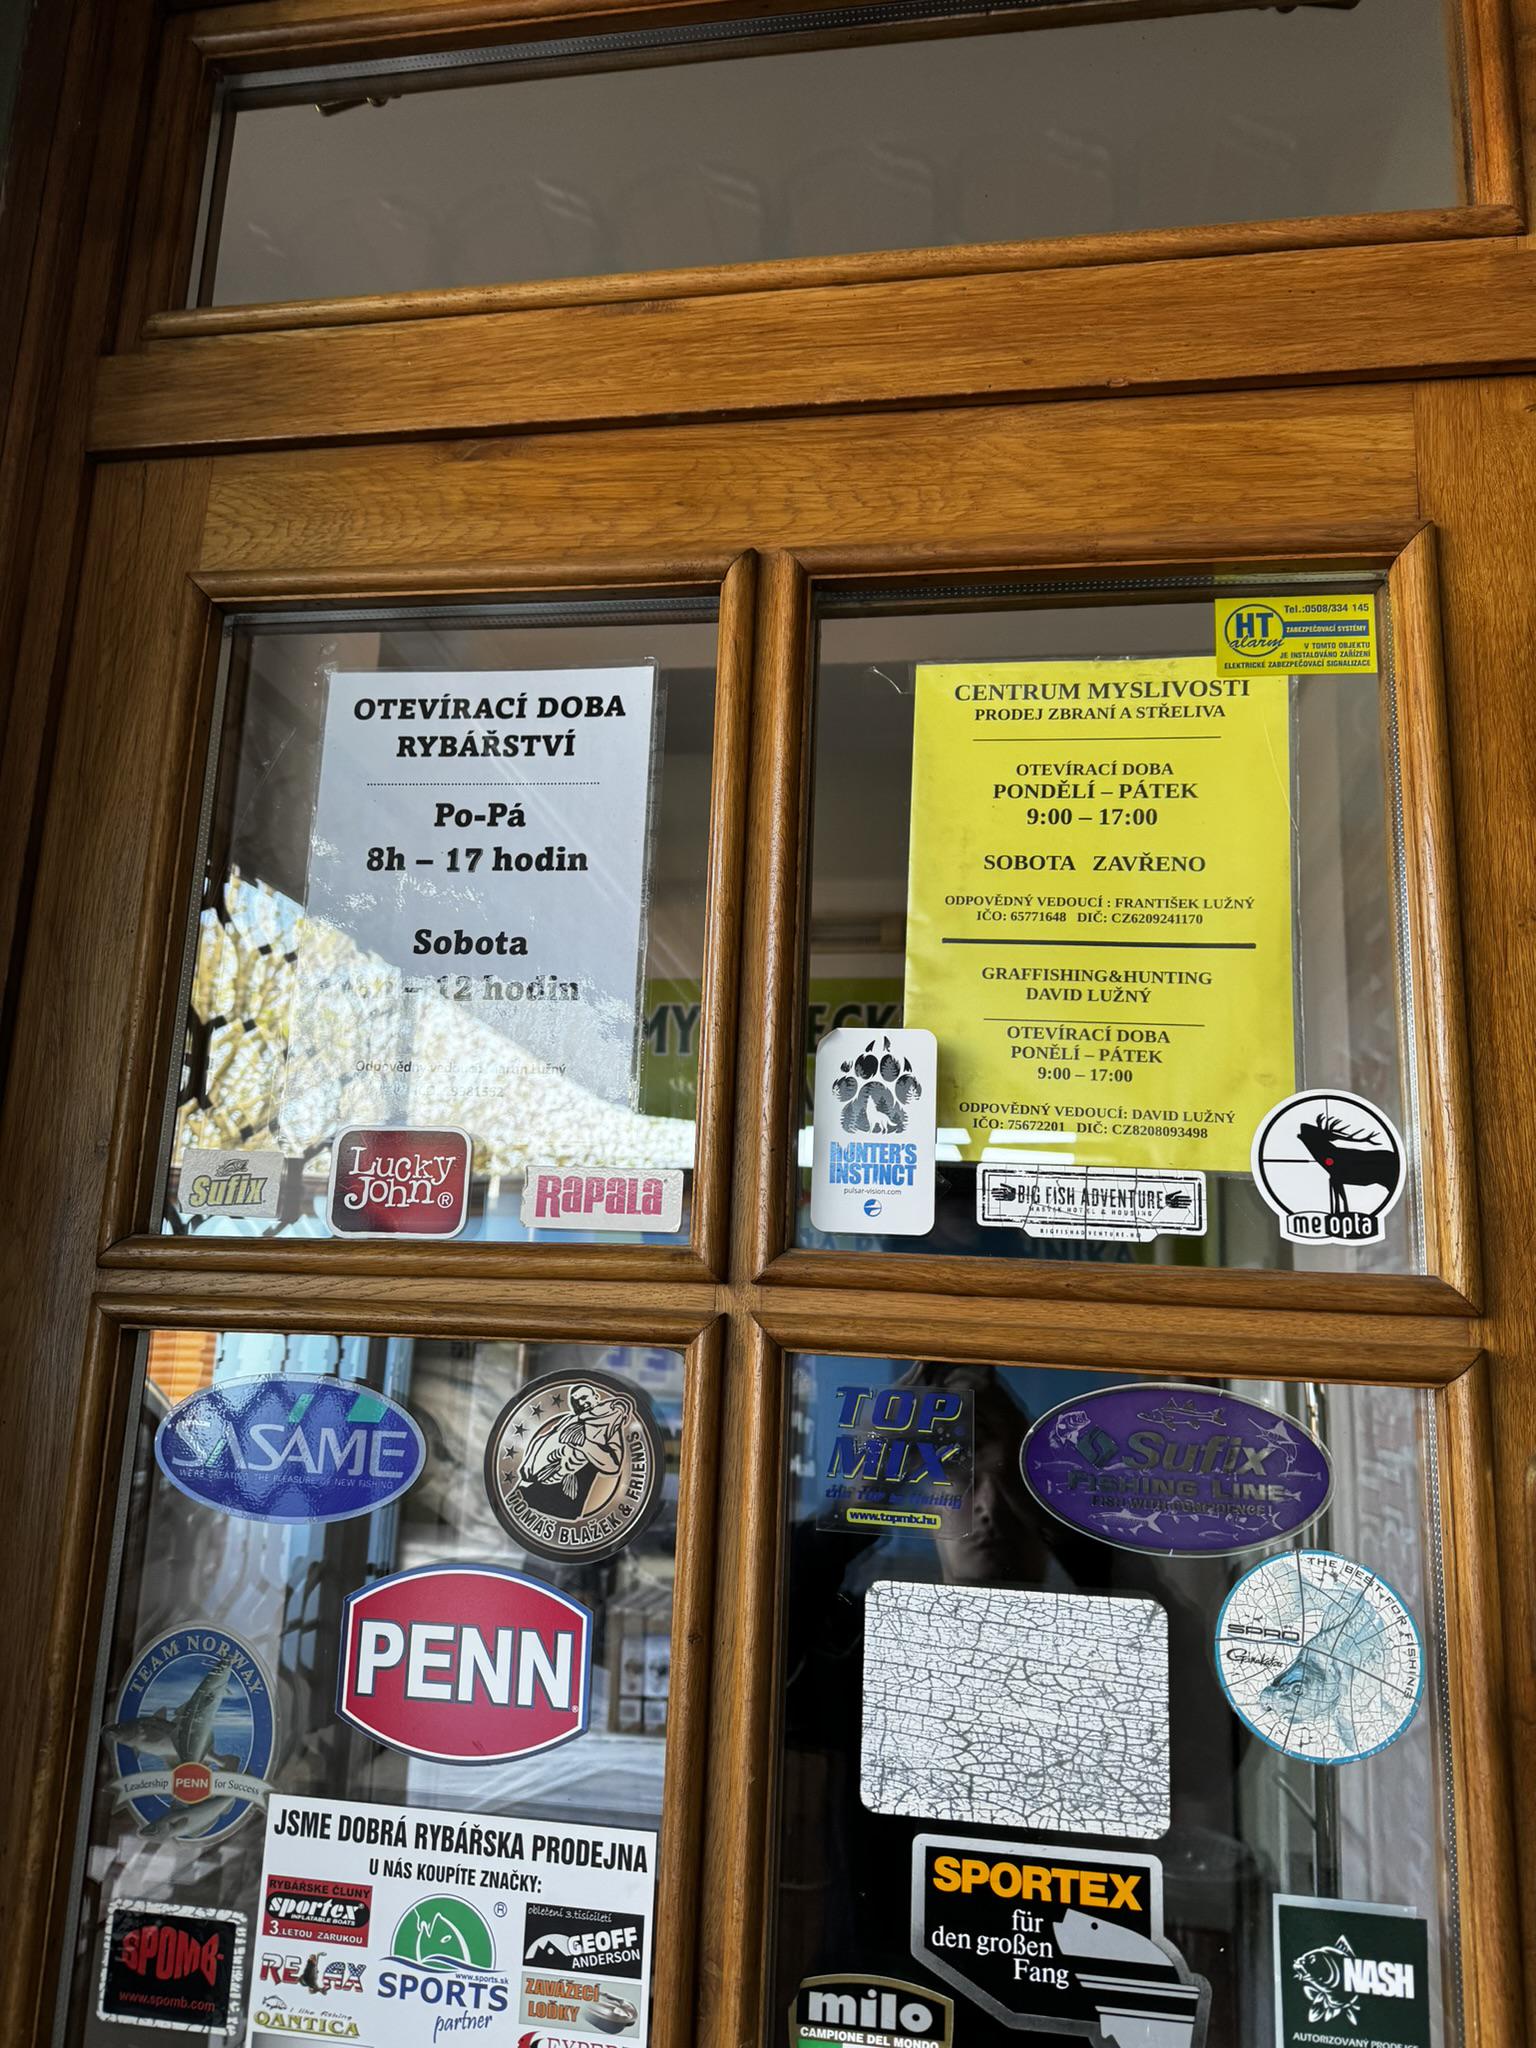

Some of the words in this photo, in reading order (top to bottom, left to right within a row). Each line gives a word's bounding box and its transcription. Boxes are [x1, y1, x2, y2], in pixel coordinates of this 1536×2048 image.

[1352, 603, 1369, 612] 145
[1236, 613, 1274, 638] HT
[1229, 635, 1284, 648] alarm
[954, 682, 1079, 701] CENTRUM
[1087, 679, 1250, 700] MYSLIVOSTI
[354, 693, 528, 720] OTEVÍRACÍ
[537, 695, 626, 720] DOBA
[975, 707, 1043, 721] PRODEJ
[1048, 704, 1117, 721] ZBRANÍ
[1119, 706, 1132, 720] A
[1136, 703, 1226, 720] STŘELIVA
[396, 729, 576, 757] RYBÁŘSTVÍ
[1016, 760, 1117, 777] OTEVÍRACÍ
[1122, 763, 1174, 776] DOBA
[993, 780, 1095, 800] PONDĚLÍ
[1118, 780, 1199, 799] PÁTEK
[434, 803, 526, 828] Po-Pá
[1027, 808, 1073, 826] 9:00
[1099, 808, 1158, 826] 17:00
[367, 847, 406, 872] 8h
[447, 848, 484, 873] 17
[492, 847, 588, 872] hodin
[983, 854, 1075, 872] SOBOTA
[1093, 852, 1206, 873] ZAVŘENO
[944, 893, 1034, 908] ODPOVĚDNÝ
[1037, 895, 1103, 909] VEDOUCÍ
[1114, 895, 1200, 910] FRANTIŠEK
[1203, 896, 1255, 910] LUŽNÝ
[976, 909, 1007, 922] IČO:
[1010, 911, 1067, 923] 65771648
[1077, 910, 1107, 924] DIČ:
[1111, 912, 1203, 925] CZ6209241170
[413, 928, 529, 956] Sobota
[483, 974, 579, 1001] hodin
[981, 966, 1213, 986] GRAFFISHING&HUNTING
[1026, 987, 1082, 1002] DAVID
[1087, 986, 1152, 1004] LUŽNÝ
[1007, 1025, 1112, 1042] OTEVÍRACÍ
[1116, 1029, 1170, 1044] DOBA
[1010, 1045, 1080, 1061] PONĚLÍ
[1099, 1047, 1164, 1064] PÁTEK
[1038, 1066, 1071, 1081] 9:00
[1090, 1068, 1133, 1083] 17:00
[959, 1101, 1051, 1116] ODPOVĚDNÝ
[1054, 1104, 1127, 1119] VEDOUCÍ:
[1132, 1108, 1179, 1122] DAVID
[1183, 1109, 1235, 1124] LUŽNÝ
[973, 1115, 1005, 1130] IČO:
[1008, 1119, 1065, 1133] 75672201
[1077, 1120, 1108, 1134] DIČ:
[1112, 1123, 1208, 1139] CZ8208093498
[348, 1146, 456, 1185] Lucky
[829, 1162, 917, 1186] INSTINCT
[189, 1173, 267, 1208] Sufix
[344, 1177, 434, 1210] John
[843, 1186, 902, 1196] pulsar-vision.com
[1018, 1184, 1040, 1205] BIG
[1045, 1186, 1075, 1205] FISH
[1081, 1187, 1164, 1210] ADVENTURE
[1294, 1213, 1372, 1238] meopta
[836, 1386, 963, 1433] TOP
[827, 1435, 960, 1486] MIX
[1123, 1431, 1276, 1476] Sufix
[335, 1478, 355, 1487] NEW
[506, 1489, 556, 1541] TOMÁŠ
[559, 1515, 622, 1545] BLAŽEK
[620, 1503, 634, 1518] &
[627, 1431, 648, 1503] FRIENDS
[849, 1511, 937, 1525] www.topmix.hu
[1227, 1623, 1300, 1642] SPRO
[1307, 1557, 1337, 1569] THE
[1344, 1565, 1382, 1593] BEST
[1384, 1596, 1407, 1626] FOR
[1403, 1632, 1417, 1699] FISHING
[129, 1640, 178, 1693] TEAM
[186, 1635, 265, 1695] NORWAY
[354, 1618, 575, 1712] PENN
[124, 1778, 169, 1793] Leadership
[175, 1777, 209, 1789] PENN
[214, 1778, 226, 1788] for
[228, 1779, 259, 1795] Success
[274, 1809, 332, 1841] JSME
[338, 1815, 408, 1849] DOBRÁ
[414, 1820, 524, 1861] RYBÁŘSKA
[532, 1834, 648, 1873] PRODEJNA
[369, 1858, 379, 1876] U
[383, 1859, 413, 1880] NÁS
[416, 1864, 477, 1887] KOUPÍTE
[480, 1869, 542, 1894] ZNAČKY:
[933, 1856, 1143, 1911] SPORTEX
[269, 1897, 359, 1921] sportex
[290, 1914, 331, 1924] INFLATABLE
[332, 1918, 355, 1927] BOATS
[1012, 1908, 1043, 1933] für
[568, 1927, 638, 1956] GEOFF
[931, 1926, 970, 1950] den
[976, 1933, 1053, 1958] großen
[122, 1925, 220, 1986] SPOMB
[572, 1949, 640, 1969] ANDERSON
[455, 1972, 509, 1985] www.sports.sk
[1013, 1958, 1069, 1989] Fang
[1343, 1957, 1415, 1999] NASH
[119, 1991, 215, 2012] www.spomb.com
[377, 1972, 508, 2011] SPORTS
[525, 1977, 601, 2003] ZAVÁŽECÍ
[527, 2000, 580, 2022] LOĎKY
[808, 1989, 933, 2033] milo
[433, 2010, 493, 2044] partner
[800, 2027, 864, 2043] CAMPIONE
[867, 2034, 890, 2047] DEL
[893, 2037, 939, 2048] MONDO
